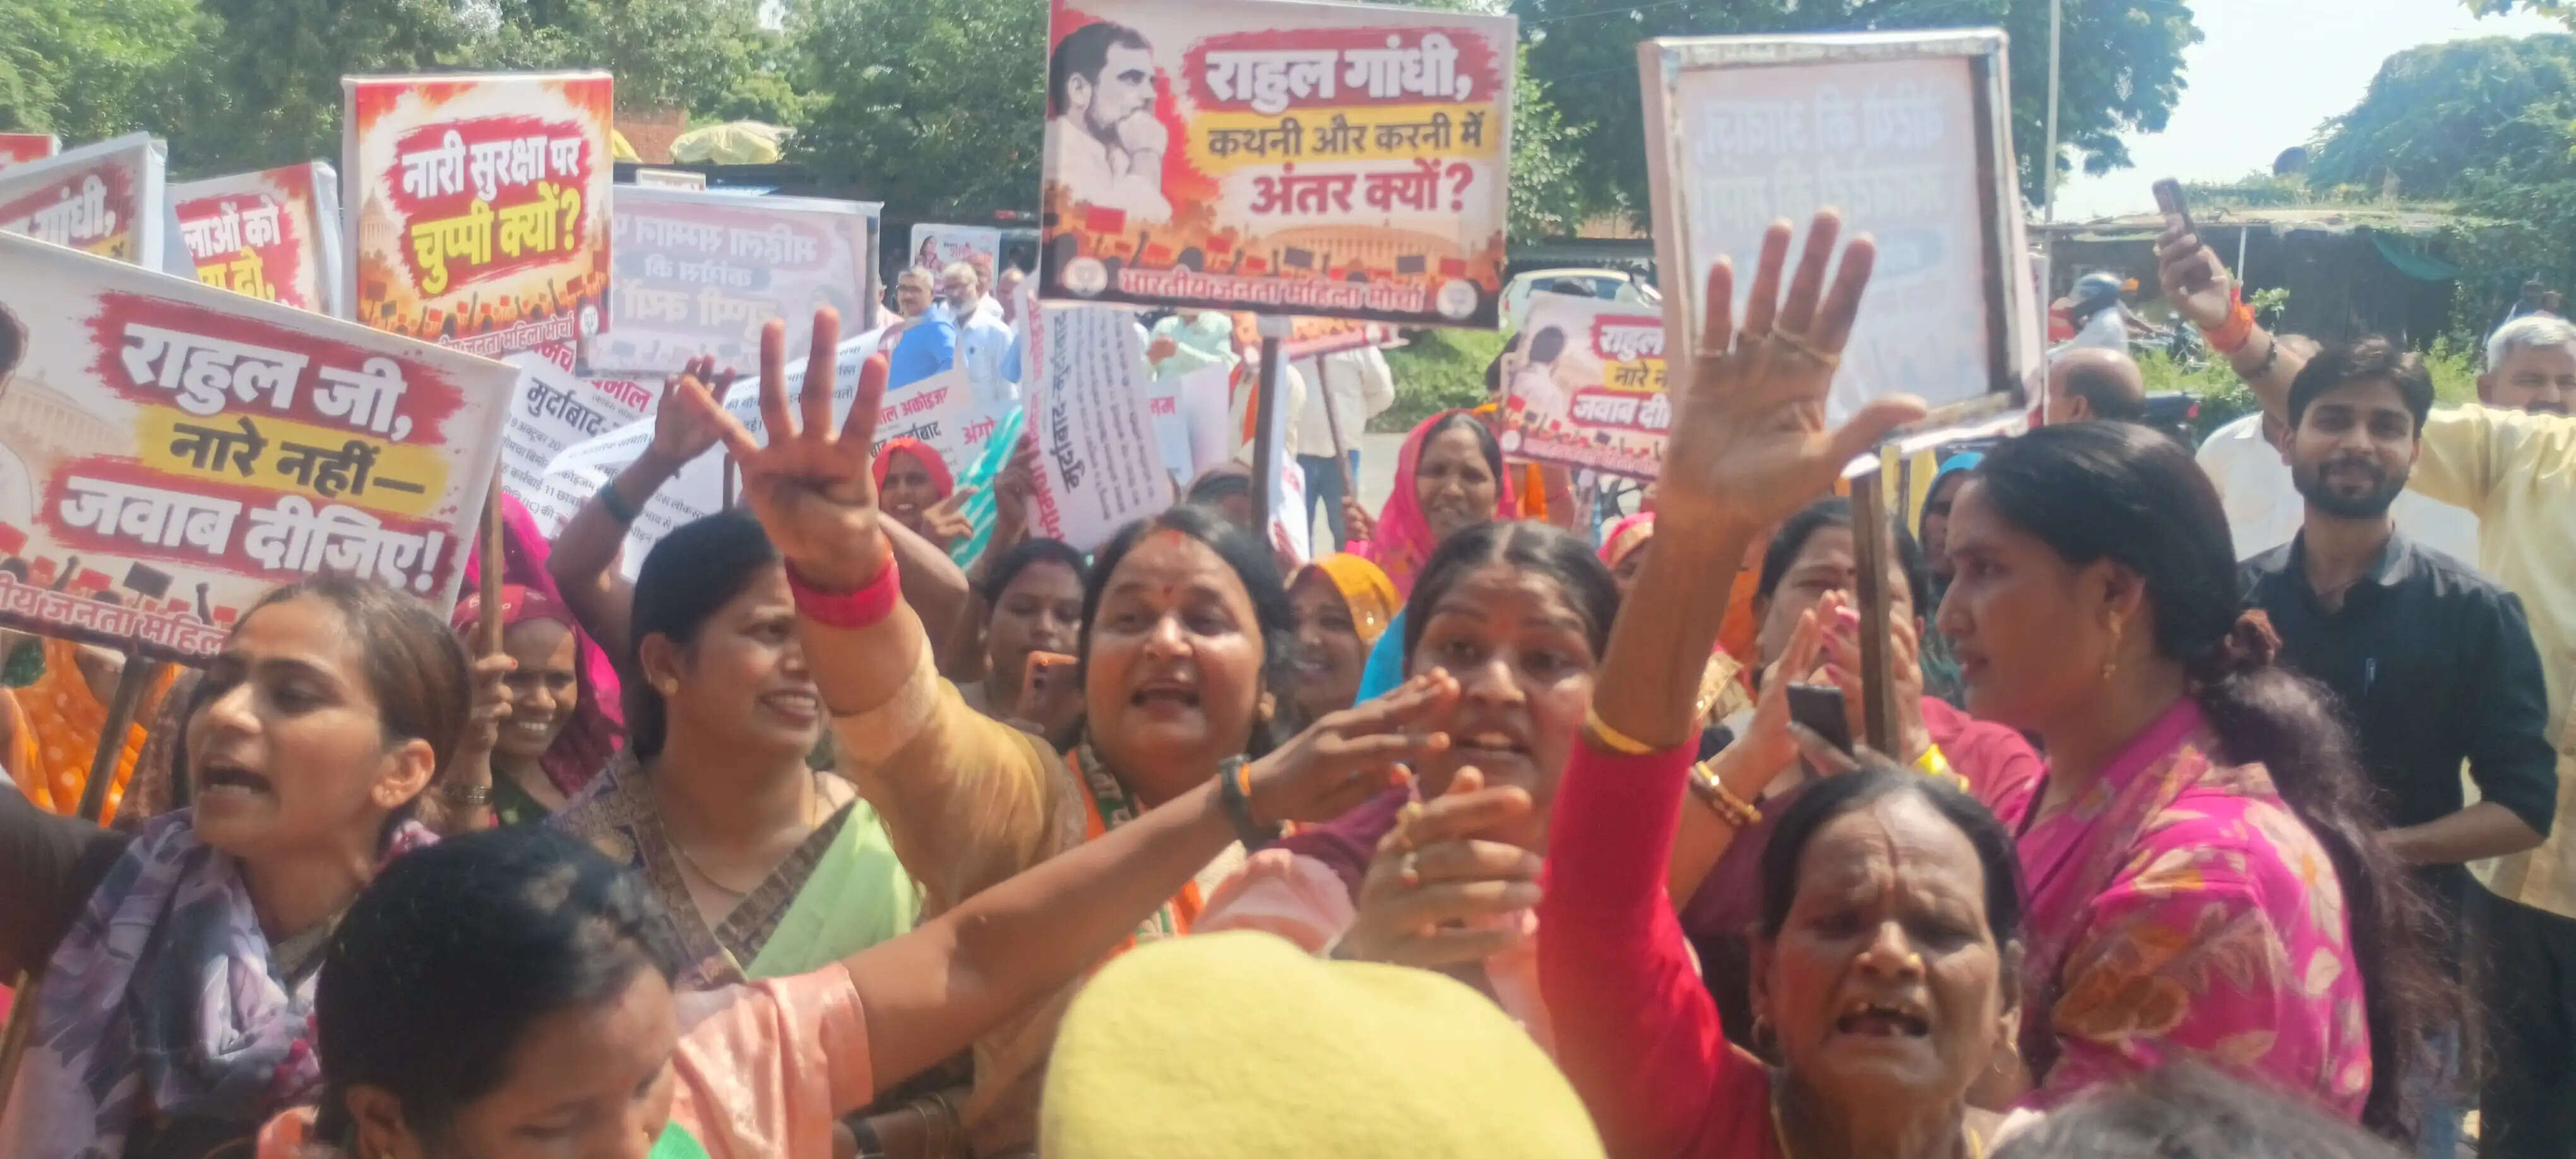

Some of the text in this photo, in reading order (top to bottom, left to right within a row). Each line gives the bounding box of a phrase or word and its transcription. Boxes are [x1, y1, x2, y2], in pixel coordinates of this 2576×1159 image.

[1205, 32, 1473, 115] राहुल गांधी,
[402, 130, 582, 202] नारी सुरक्षा पर
[1207, 110, 1484, 158] कथनी और करनी में
[35, 174, 116, 246] गांधी,
[1249, 157, 1474, 215] अंतर क्यों?
[181, 193, 281, 258] लाओं को
[412, 181, 581, 295] चुप्पी क्यों?
[1599, 325, 1666, 362] राहुल
[1614, 359, 1650, 387] नारे
[122, 323, 413, 442] राहुल जी,
[1573, 394, 1640, 424] जवाब
[170, 416, 268, 477] नारे
[548, 438, 561, 451] 20
[60, 477, 444, 592] जवाब दीजिए!
[42, 588, 138, 638] जनता
[138, 611, 232, 657] महिल
